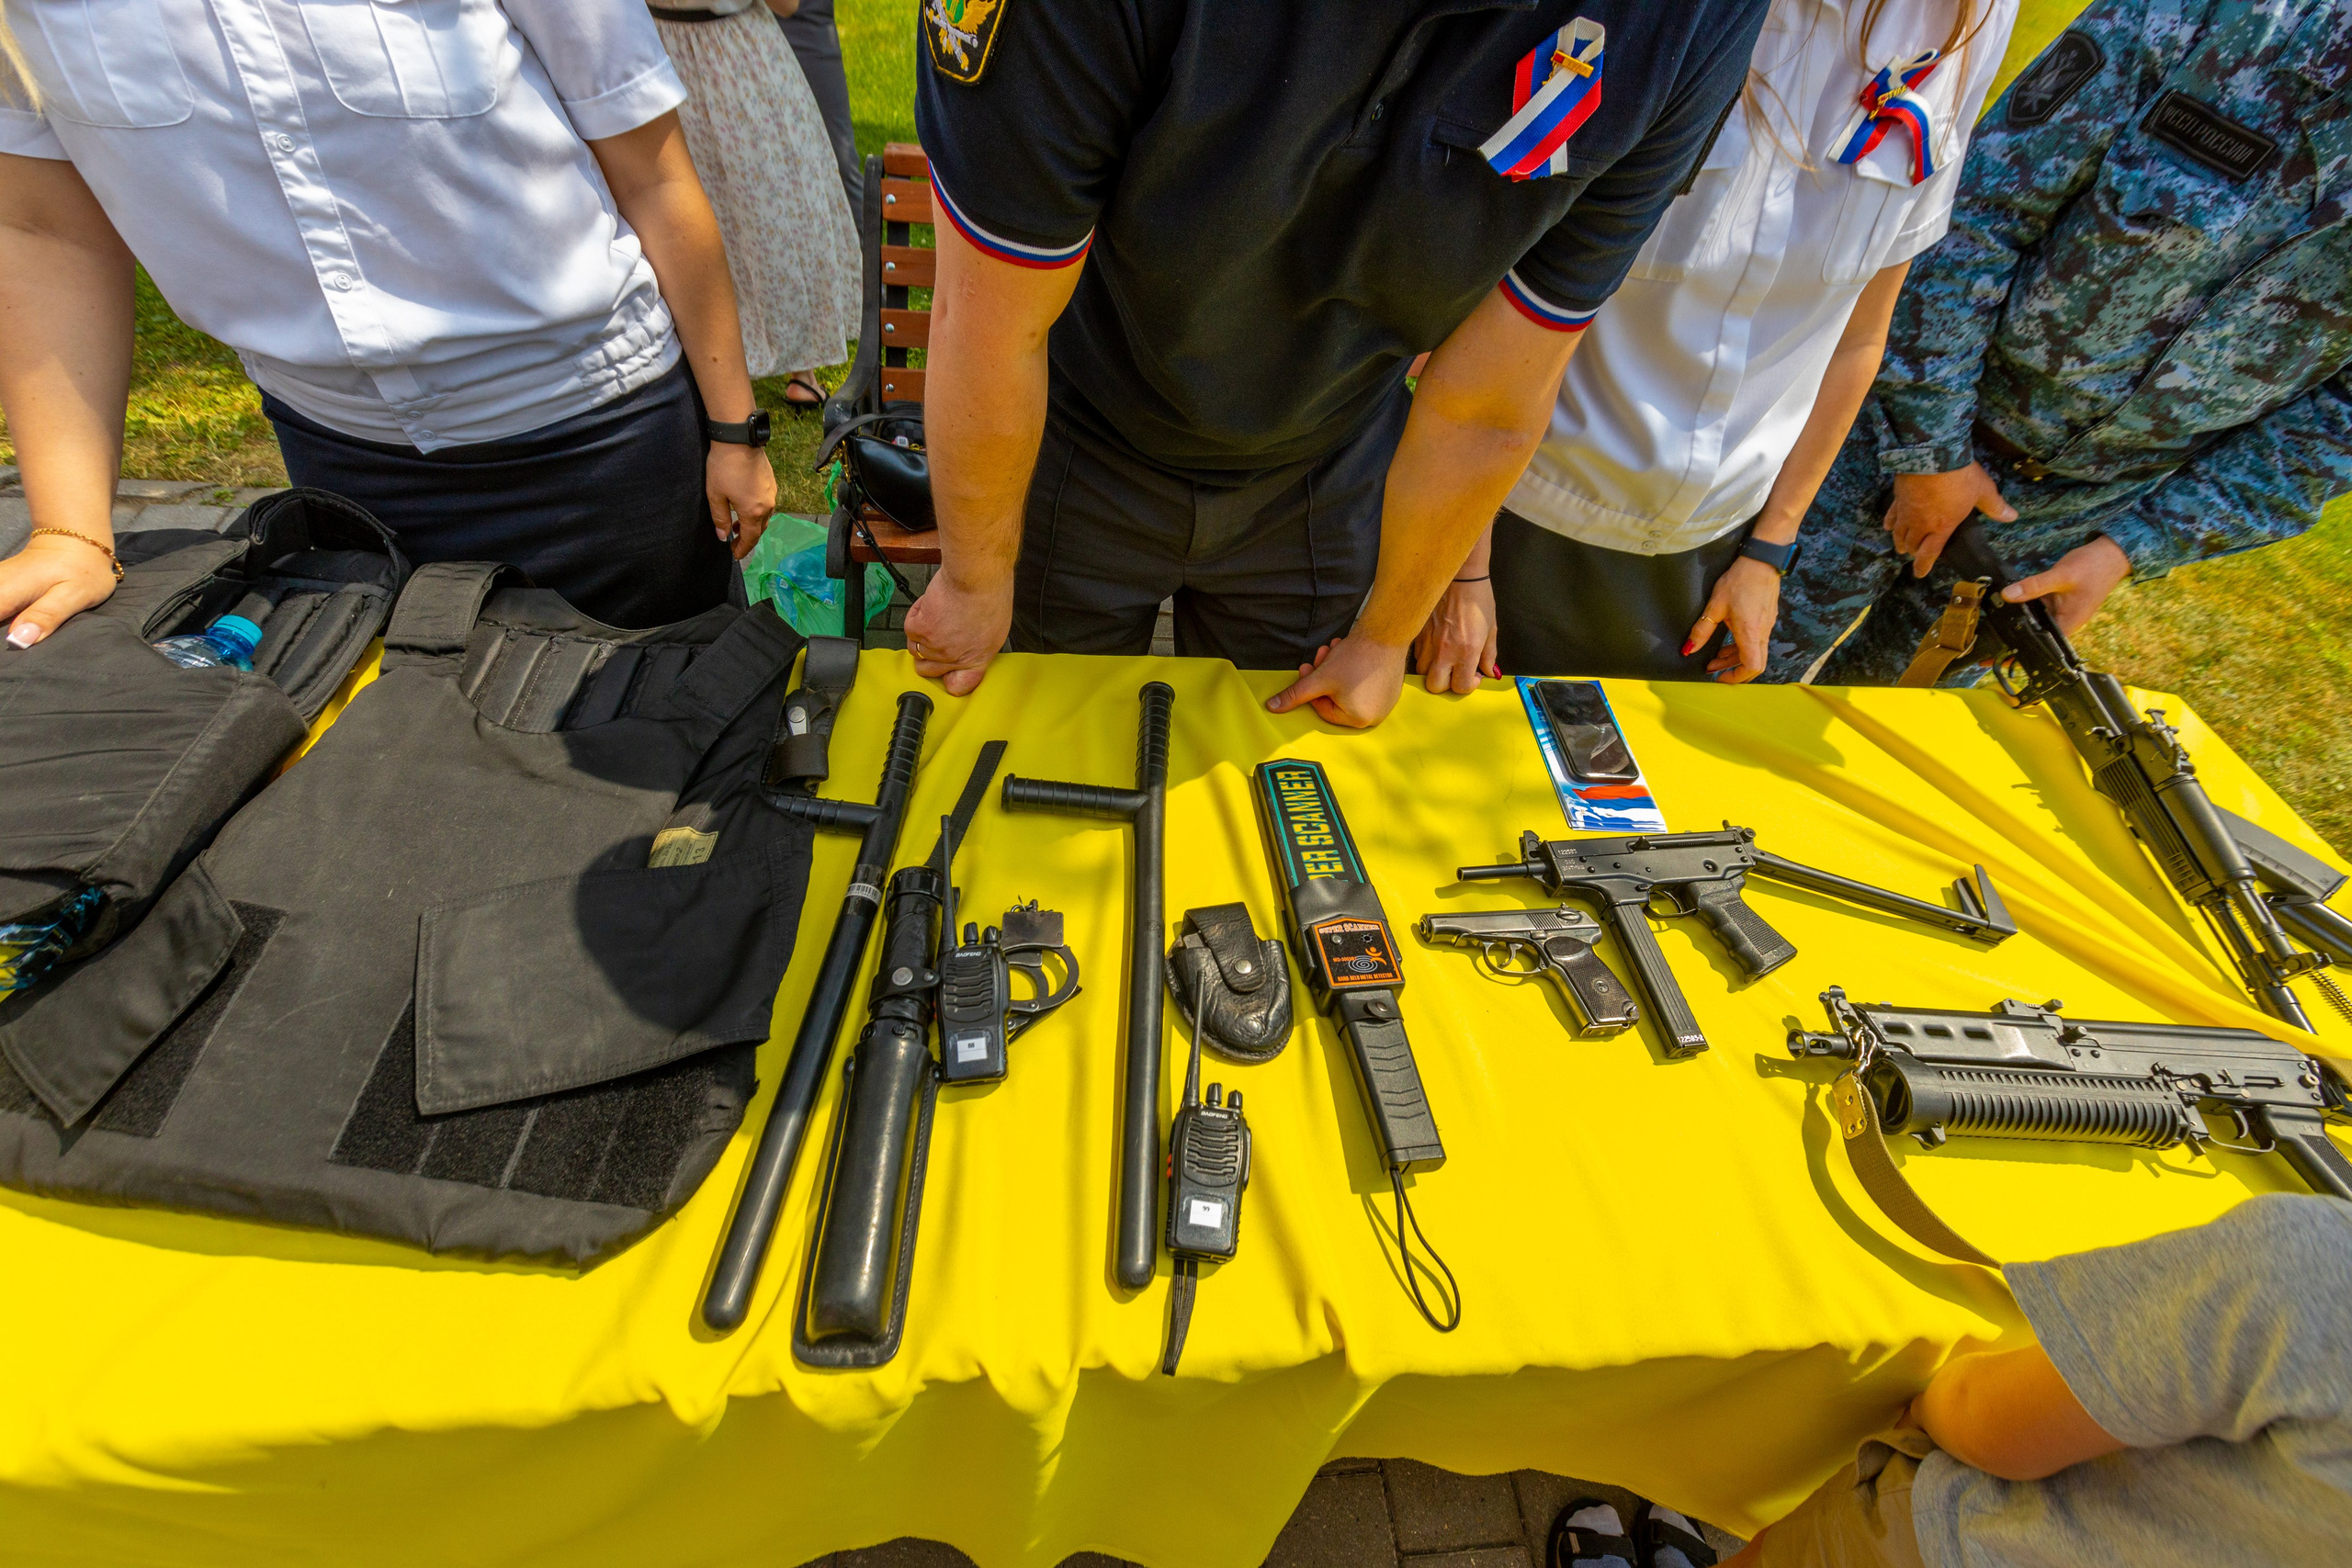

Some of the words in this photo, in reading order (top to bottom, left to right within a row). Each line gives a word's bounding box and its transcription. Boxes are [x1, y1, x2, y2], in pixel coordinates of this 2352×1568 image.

[2192, 123, 2256, 164] РОССИИ
[1274, 771, 1334, 846] SCANNER
[1343, 922, 1380, 932] SCANNER
[1201, 1111, 1228, 1120] BAOFENG
